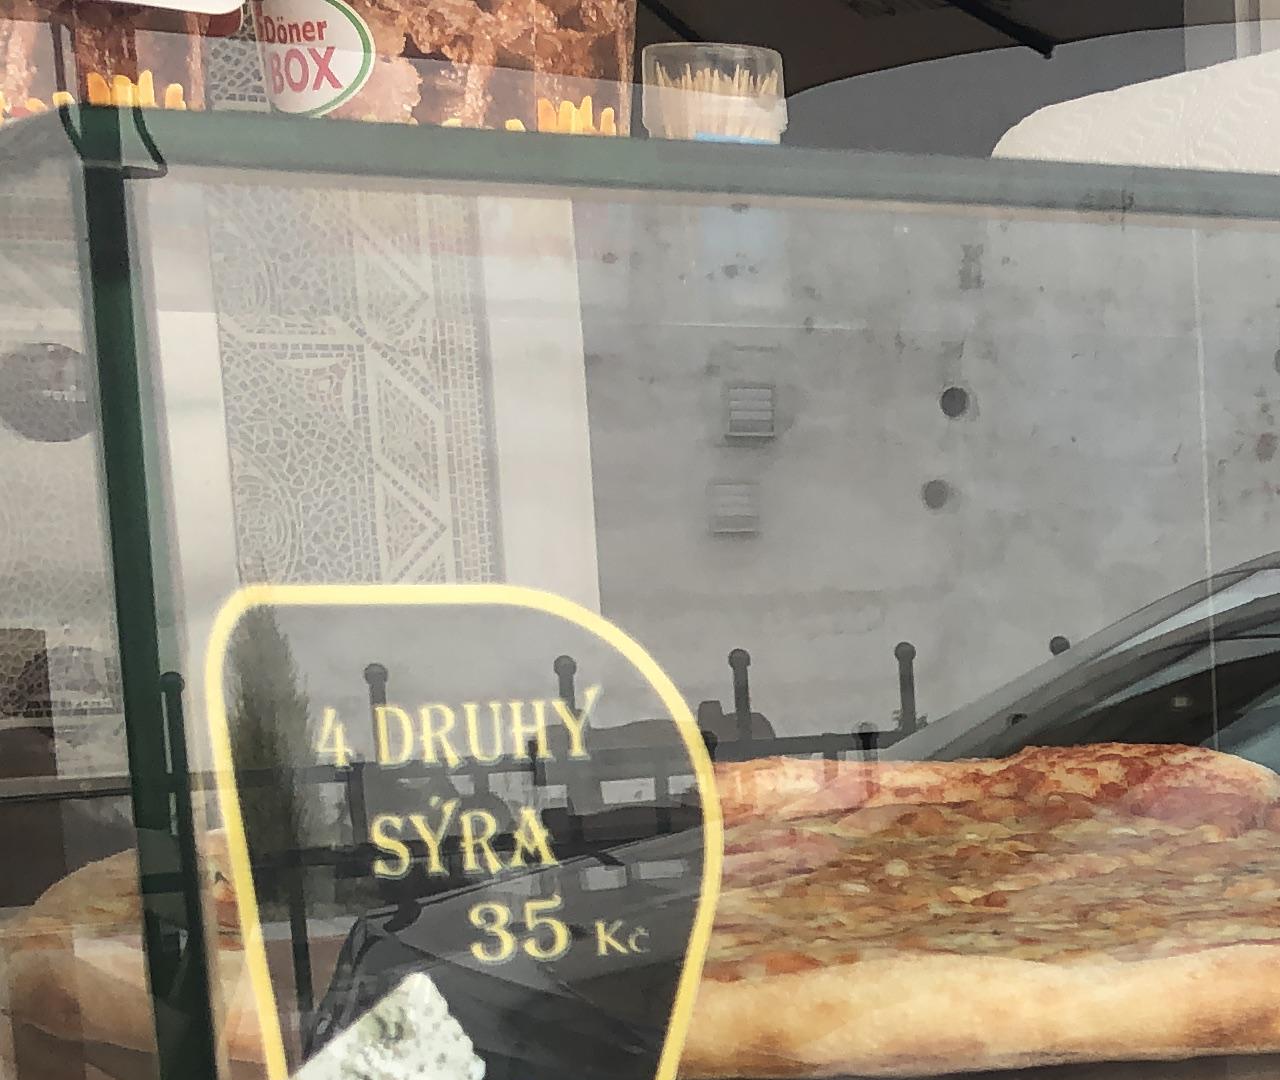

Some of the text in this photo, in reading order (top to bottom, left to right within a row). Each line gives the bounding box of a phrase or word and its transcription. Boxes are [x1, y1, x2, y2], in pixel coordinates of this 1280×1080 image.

[264, 16, 327, 44] Döner
[270, 46, 343, 94] BOX
[315, 687, 601, 770] 4 DRUHÝ
[370, 796, 560, 880] SÝRA
[469, 895, 650, 963] 35 Kč
